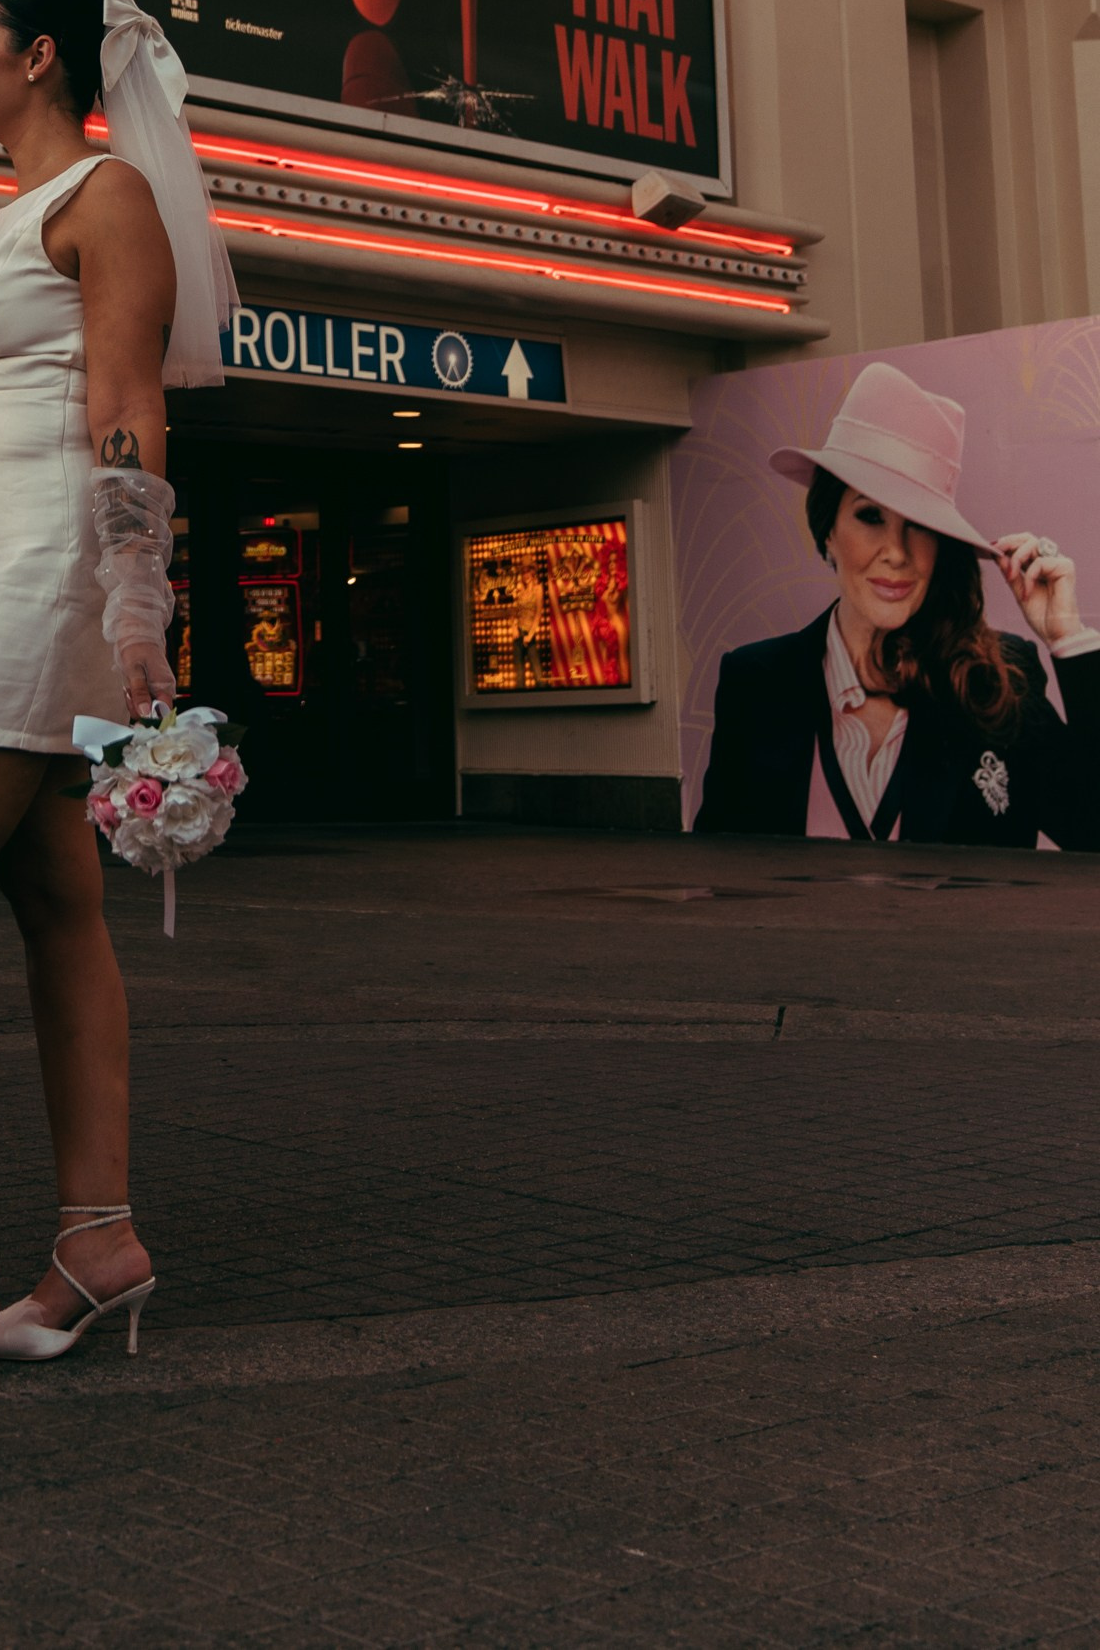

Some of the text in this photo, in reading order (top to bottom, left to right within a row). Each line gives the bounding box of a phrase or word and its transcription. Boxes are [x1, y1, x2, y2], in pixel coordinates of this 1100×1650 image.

[225, 18, 284, 41] ticketmaster
[554, 23, 697, 148] WALK
[233, 307, 406, 384] ROLLER
